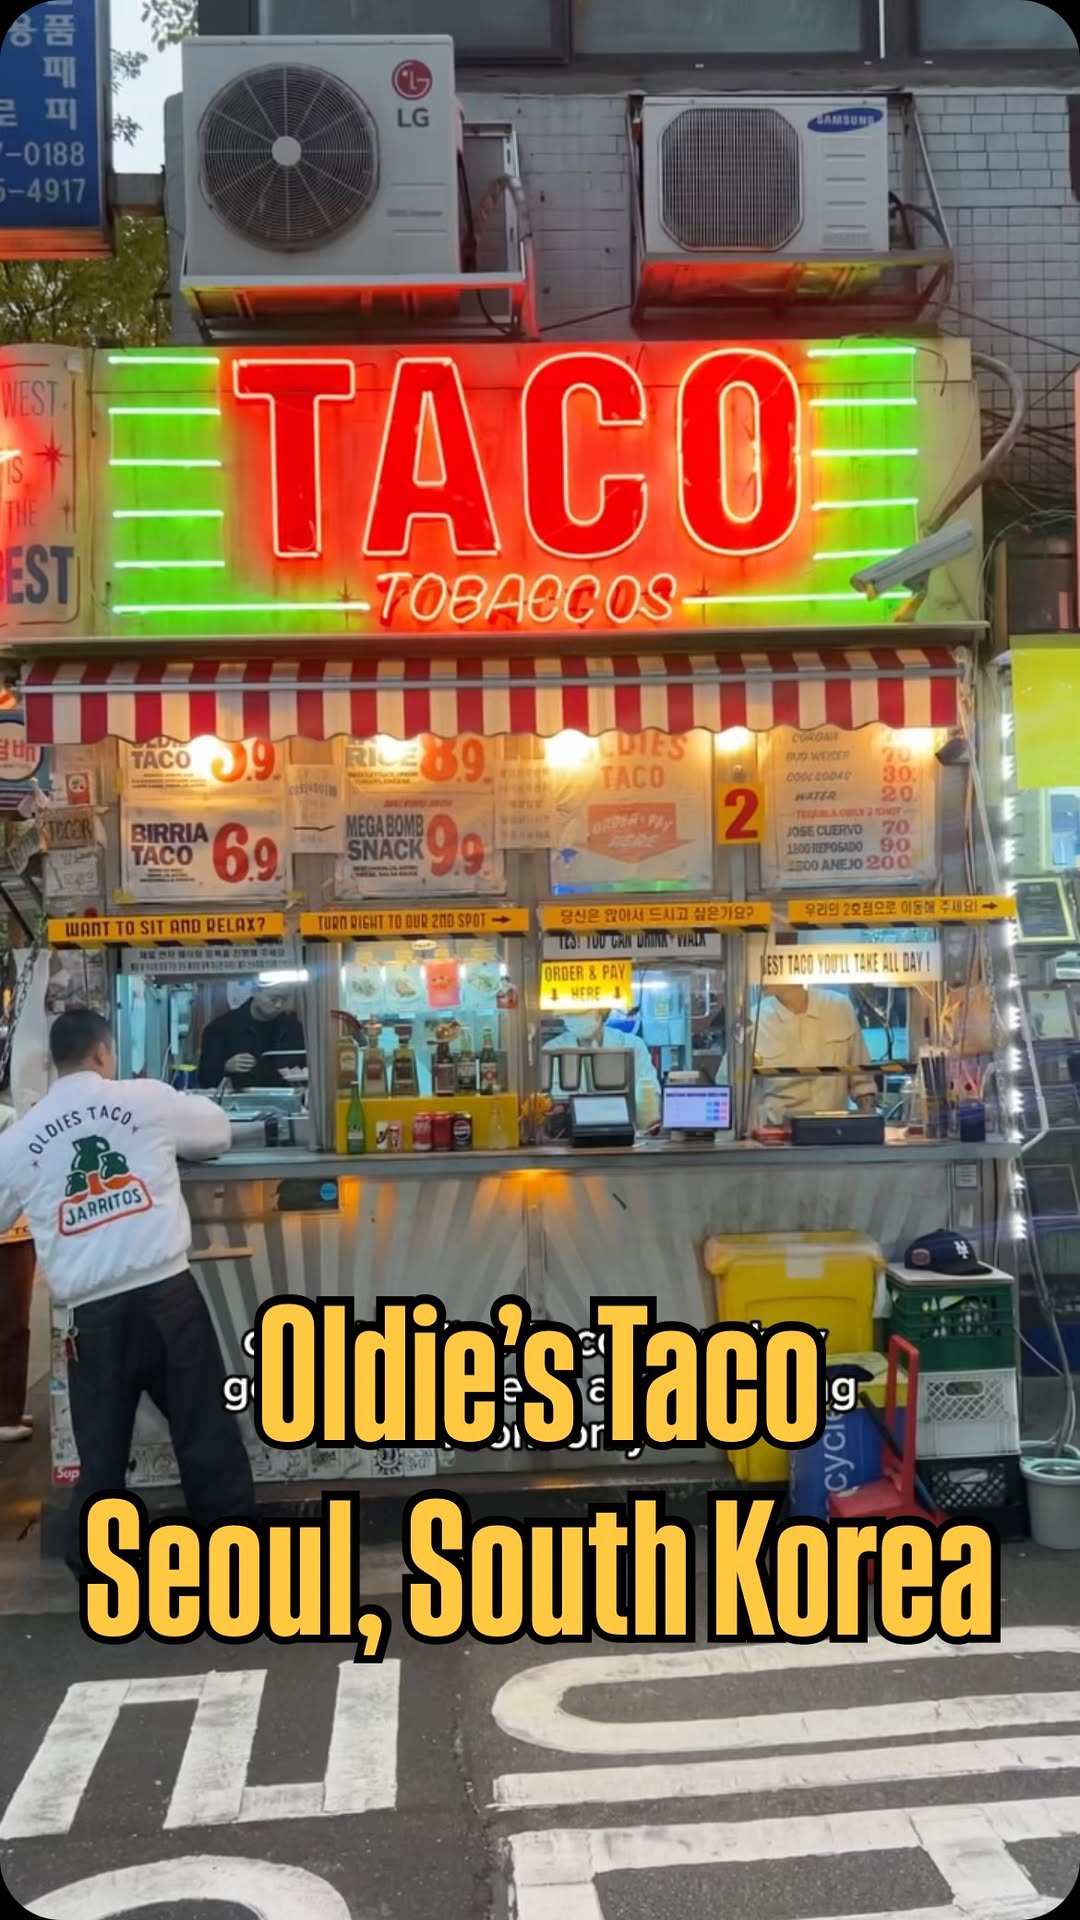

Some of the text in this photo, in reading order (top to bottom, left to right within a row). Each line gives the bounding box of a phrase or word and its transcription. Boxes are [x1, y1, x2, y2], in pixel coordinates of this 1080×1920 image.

[398, 107, 429, 128] LG
[816, 114, 875, 126] SAMSUNG
[0, 141, 84, 166] -0188
[2, 381, 59, 418] WEST
[233, 348, 801, 560] TACO
[5, 499, 37, 528] THE
[377, 572, 676, 623] TOBACCOS
[131, 751, 192, 769] TACO
[601, 765, 664, 789] TACO
[724, 788, 759, 840] 2
[131, 822, 208, 844] BIRRIA
[346, 814, 424, 838] MEGA BOMB
[787, 825, 814, 837] JOSE
[817, 824, 862, 836] CUERVO
[131, 846, 193, 867] TACO
[213, 822, 278, 883] 6.9
[347, 839, 424, 861] SNACK
[318, 912, 486, 930] TURN RIGHT TO OUR 2ND SPOT
[560, 909, 601, 924] 당신은
[650, 907, 688, 922] 드시고
[65, 917, 266, 937] WANT TO SIT AND RELAX?
[545, 963, 625, 981] ORDER & PAY
[787, 954, 813, 975] TACO
[817, 954, 850, 974] YOU'LL
[854, 953, 878, 974] TAKE
[883, 952, 899, 973] ALL
[903, 952, 923, 973] DAY
[571, 986, 600, 1001] HERE
[29, 1106, 132, 1154] OLDIES TACO
[65, 1188, 142, 1226] JARRITOS
